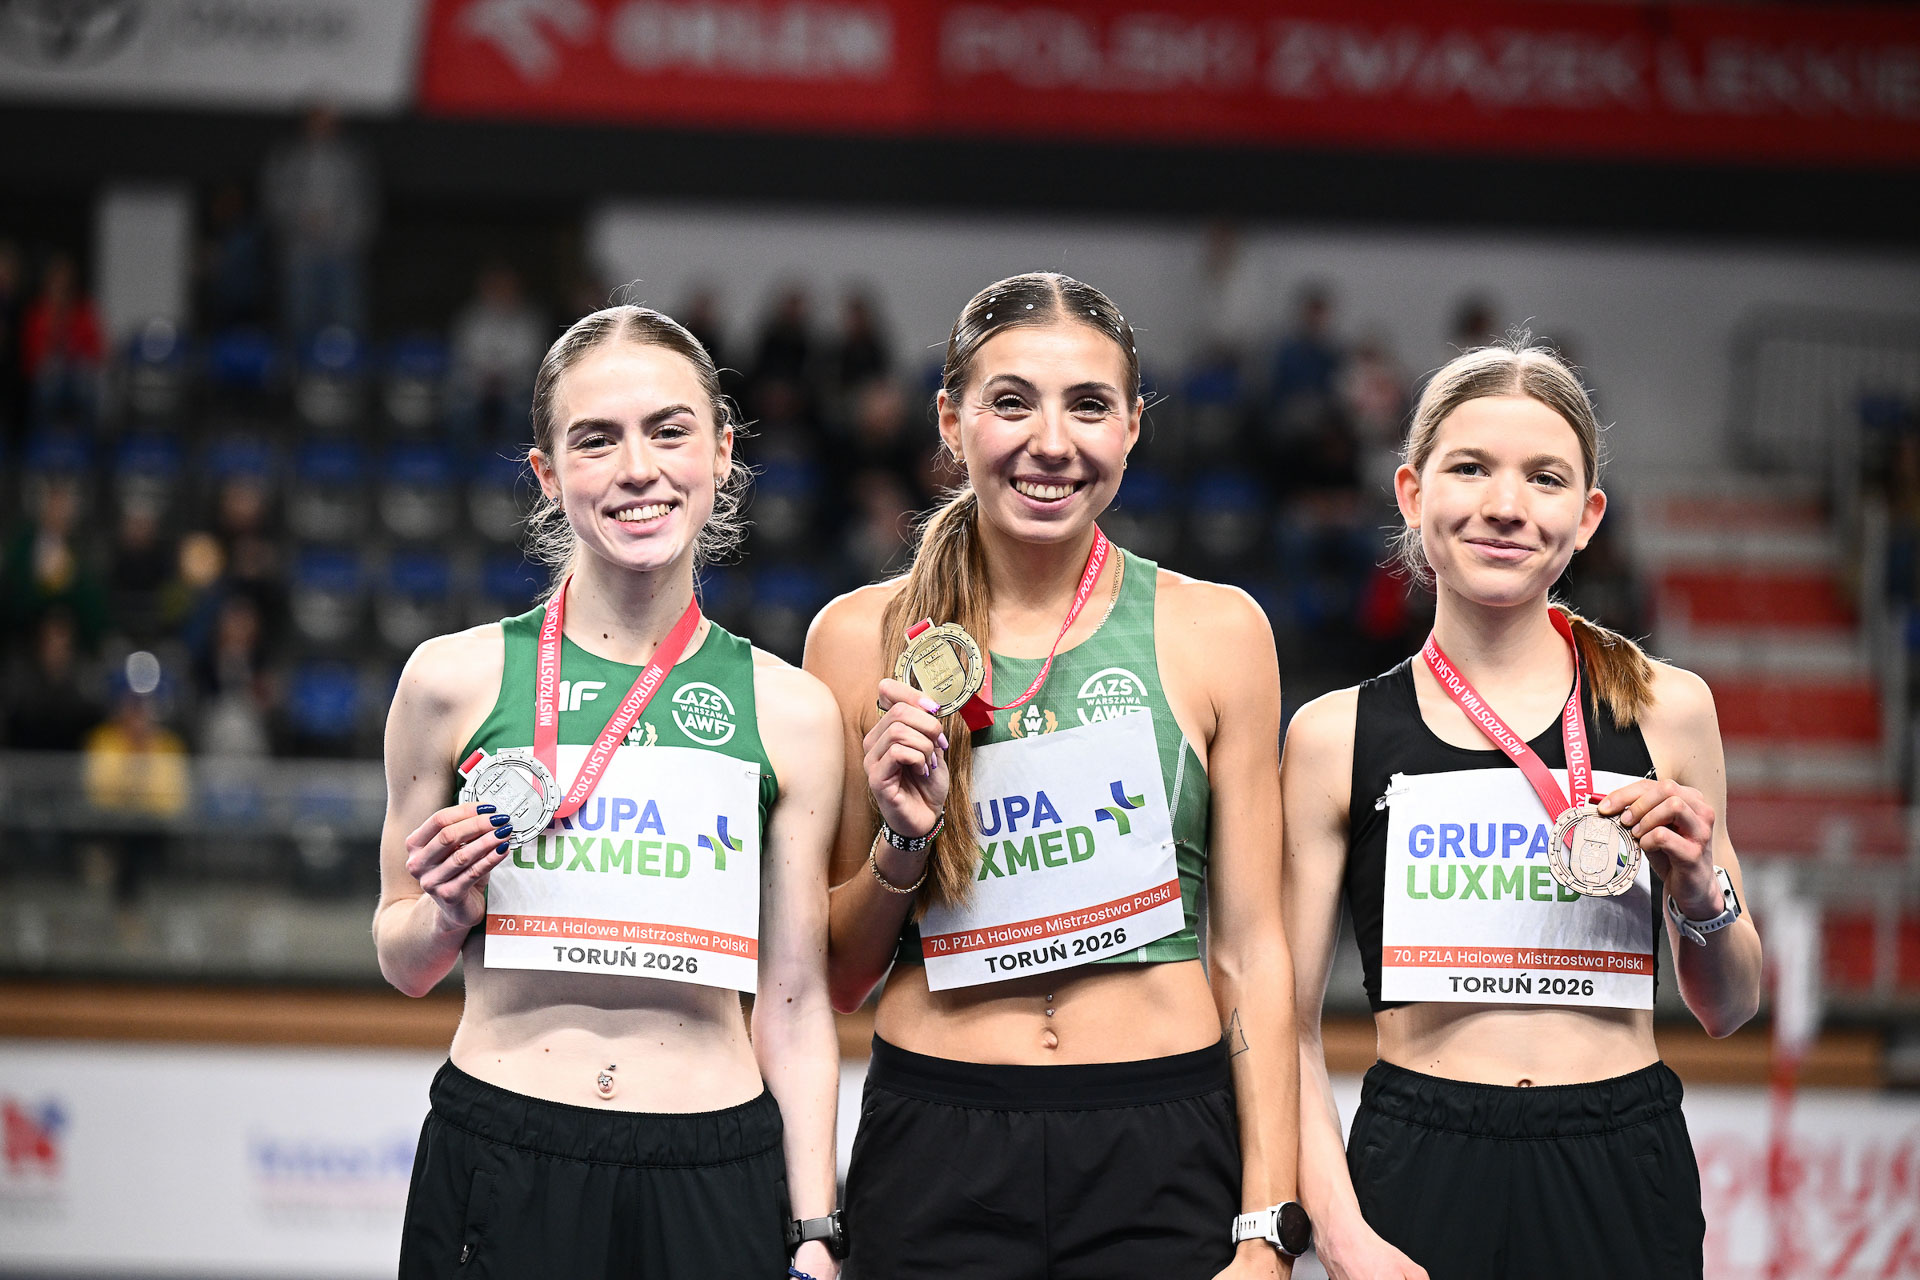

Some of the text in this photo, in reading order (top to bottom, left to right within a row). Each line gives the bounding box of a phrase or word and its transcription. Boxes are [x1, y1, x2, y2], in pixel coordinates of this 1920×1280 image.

[1080, 557, 1100, 599] POLSKI
[543, 605, 559, 641] POLSKI
[540, 641, 556, 727] MISTRZOSTWA
[1093, 678, 1134, 697] AZS
[1434, 657, 1466, 696] POLSKI
[608, 663, 665, 733] MISTRZOSTWA
[680, 704, 729, 722] WARSZAWA
[685, 690, 723, 712] AZS
[1086, 696, 1142, 706] WARSZAWA
[683, 712, 727, 735] AWF
[1460, 689, 1527, 757] MISTRZOSTWA
[584, 733, 618, 777] POLSKI
[1568, 741, 1588, 790] POLSKI
[567, 775, 593, 804] 2026
[974, 790, 1064, 837] UPA
[977, 825, 1096, 881] XMED
[497, 917, 749, 954] 70. PZLA Halowe Mistrzostwa Polski
[930, 885, 1172, 953] 70. PZLA Halowe Mistrzostwa Polski
[553, 945, 698, 974] TORUŃ 2026
[984, 927, 1128, 974] TORUŃ 2026
[1394, 949, 1644, 970] 70. PZLA Halowe Mistrzostwa Polski
[1449, 973, 1594, 996] TORUŃ 2026
